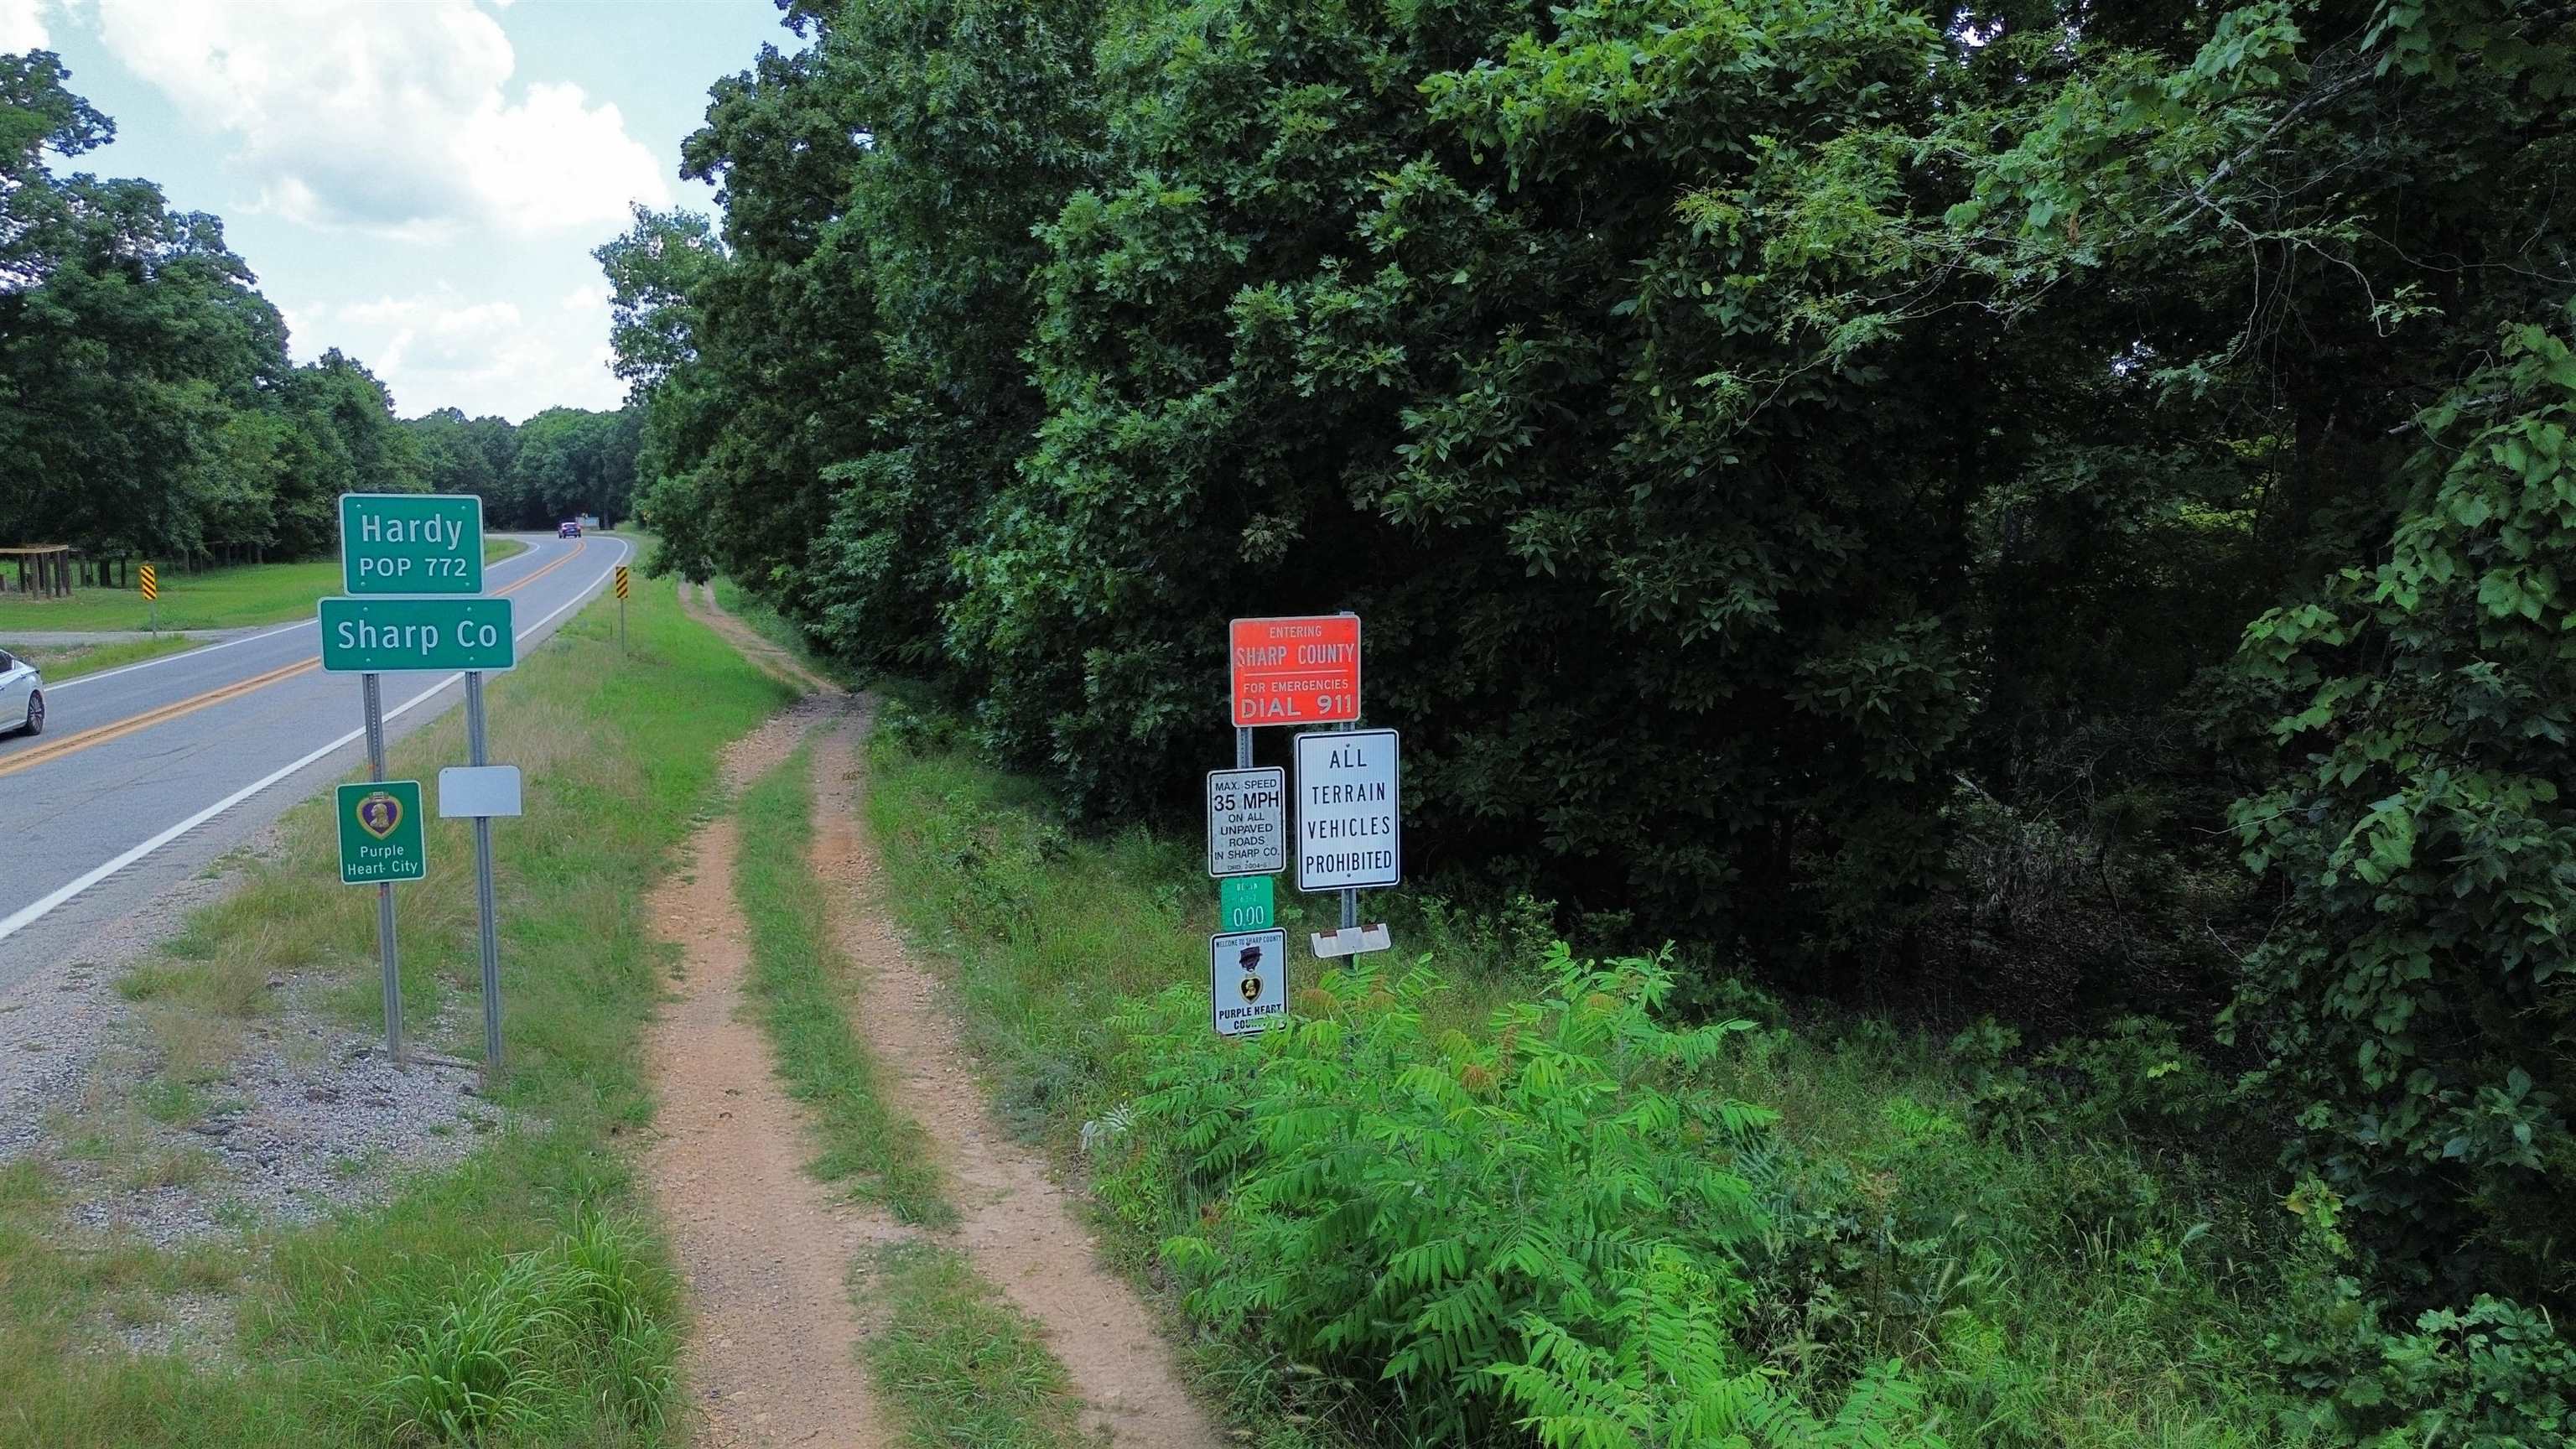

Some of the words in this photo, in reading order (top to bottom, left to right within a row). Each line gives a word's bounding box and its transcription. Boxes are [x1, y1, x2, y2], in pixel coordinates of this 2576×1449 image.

[361, 513, 463, 551] Hardy
[360, 558, 412, 576] POP
[425, 558, 467, 576] 772
[338, 619, 439, 656] Sharp
[457, 621, 497, 647] Co
[1270, 625, 1322, 639] ENTERING
[1236, 646, 1287, 667] SHARP
[1298, 643, 1355, 665] COUNTY
[1243, 682, 1266, 693] FOR
[1271, 678, 1348, 693] EMERGENCIES
[1241, 697, 1301, 719] DIAL
[1317, 694, 1352, 714] 911
[1329, 749, 1368, 769] ALL
[1215, 782, 1240, 791] MAX.
[1244, 779, 1277, 789] SPEED
[1312, 782, 1385, 805] TERRAIN
[1214, 794, 1235, 812] 35
[1244, 791, 1279, 810] MPH
[1228, 813, 1243, 823] ON
[1247, 813, 1265, 822] ALL
[1220, 823, 1273, 835] UNPAVED
[1308, 816, 1390, 839] VEHICLES
[1229, 836, 1265, 847] ROADS
[361, 844, 404, 859] Purple
[1214, 851, 1223, 860] IN
[1228, 849, 1259, 860] SHARP
[1263, 847, 1280, 856] CO.
[348, 862, 384, 875] Heart
[392, 860, 418, 874] City
[1306, 850, 1392, 875] PROHIBITED
[1233, 906, 1264, 927] 0.00
[1216, 939, 1238, 948] WELCOME
[1246, 937, 1263, 945] SHARP
[1263, 935, 1282, 943] COUNTY
[1219, 1007, 1252, 1020] PURPLE
[1254, 1004, 1282, 1015] HEART
